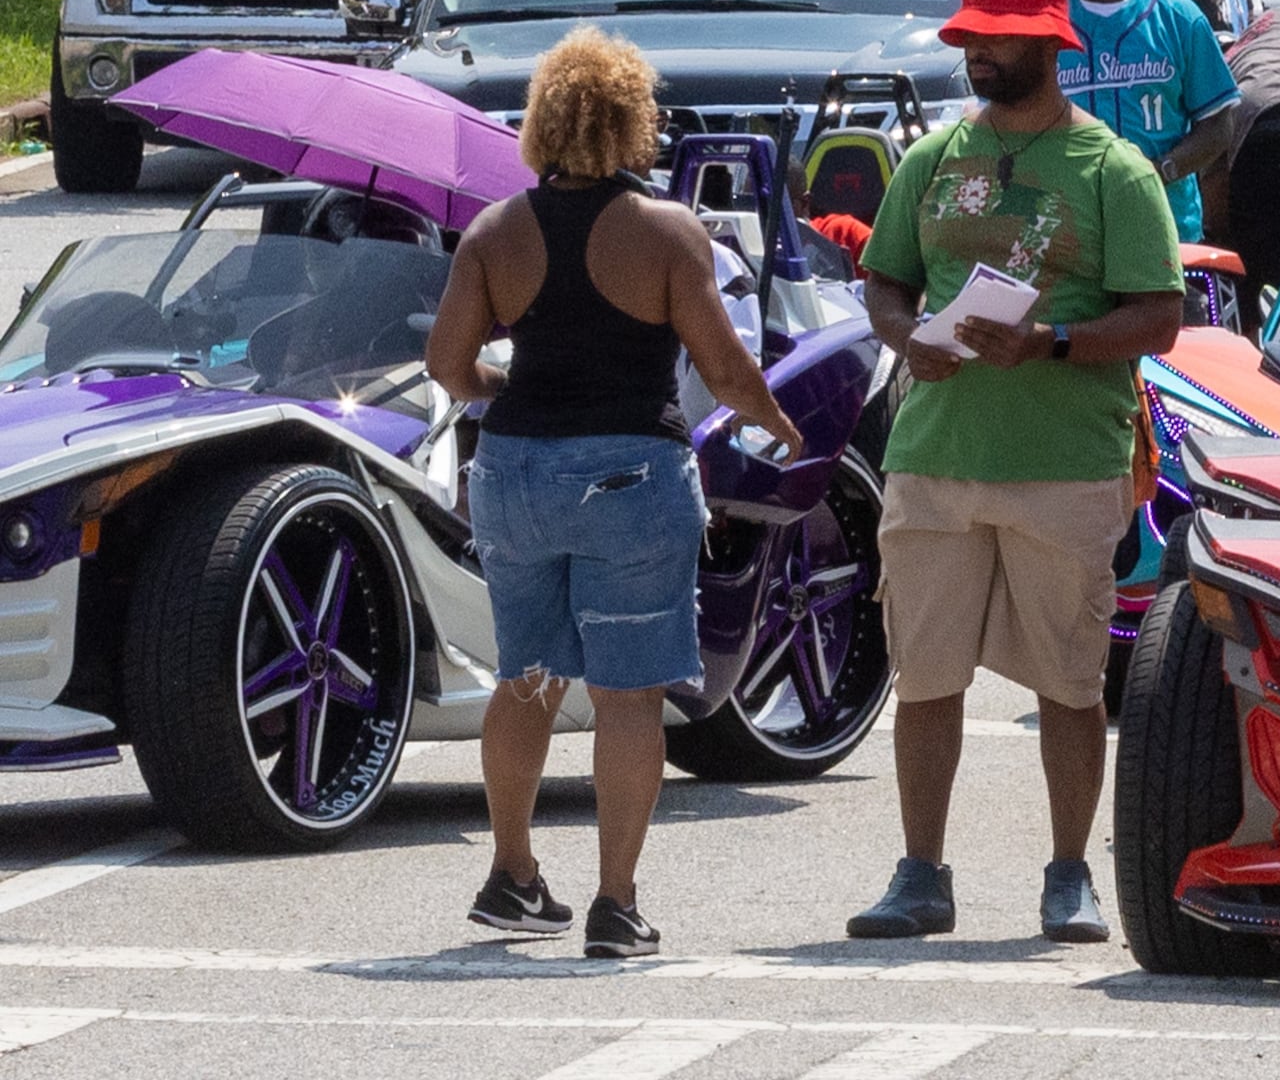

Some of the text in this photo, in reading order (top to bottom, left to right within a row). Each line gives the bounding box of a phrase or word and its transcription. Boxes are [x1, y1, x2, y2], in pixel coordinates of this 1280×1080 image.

[1097, 52, 1175, 88] Slingshot
[1140, 93, 1163, 131] 11
[318, 717, 397, 816] Too Much
